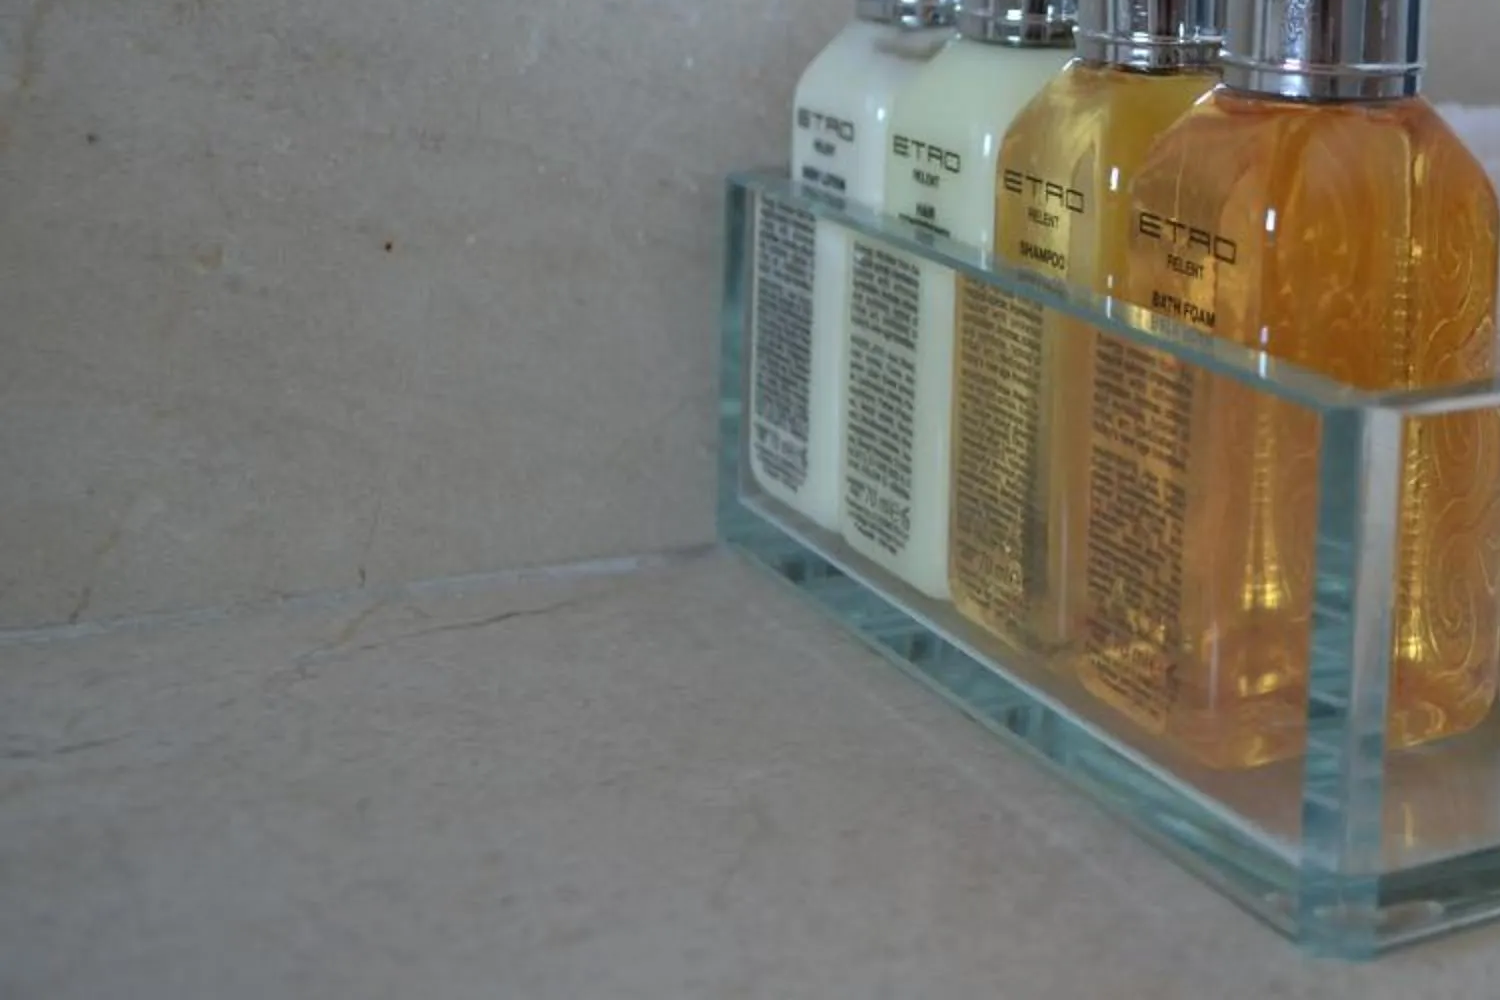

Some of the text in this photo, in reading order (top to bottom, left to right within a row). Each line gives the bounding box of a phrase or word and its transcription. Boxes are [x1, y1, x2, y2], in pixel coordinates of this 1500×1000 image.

[797, 107, 855, 143] ETRO
[892, 133, 961, 174] ETRO
[1002, 168, 1085, 214] ETRO
[1027, 206, 1060, 229] RELENT
[1019, 240, 1066, 271] SHAMPOO
[1139, 211, 1238, 265] ETRO
[1166, 252, 1205, 281] RELENT
[1151, 289, 1217, 329] BATH FOAM
